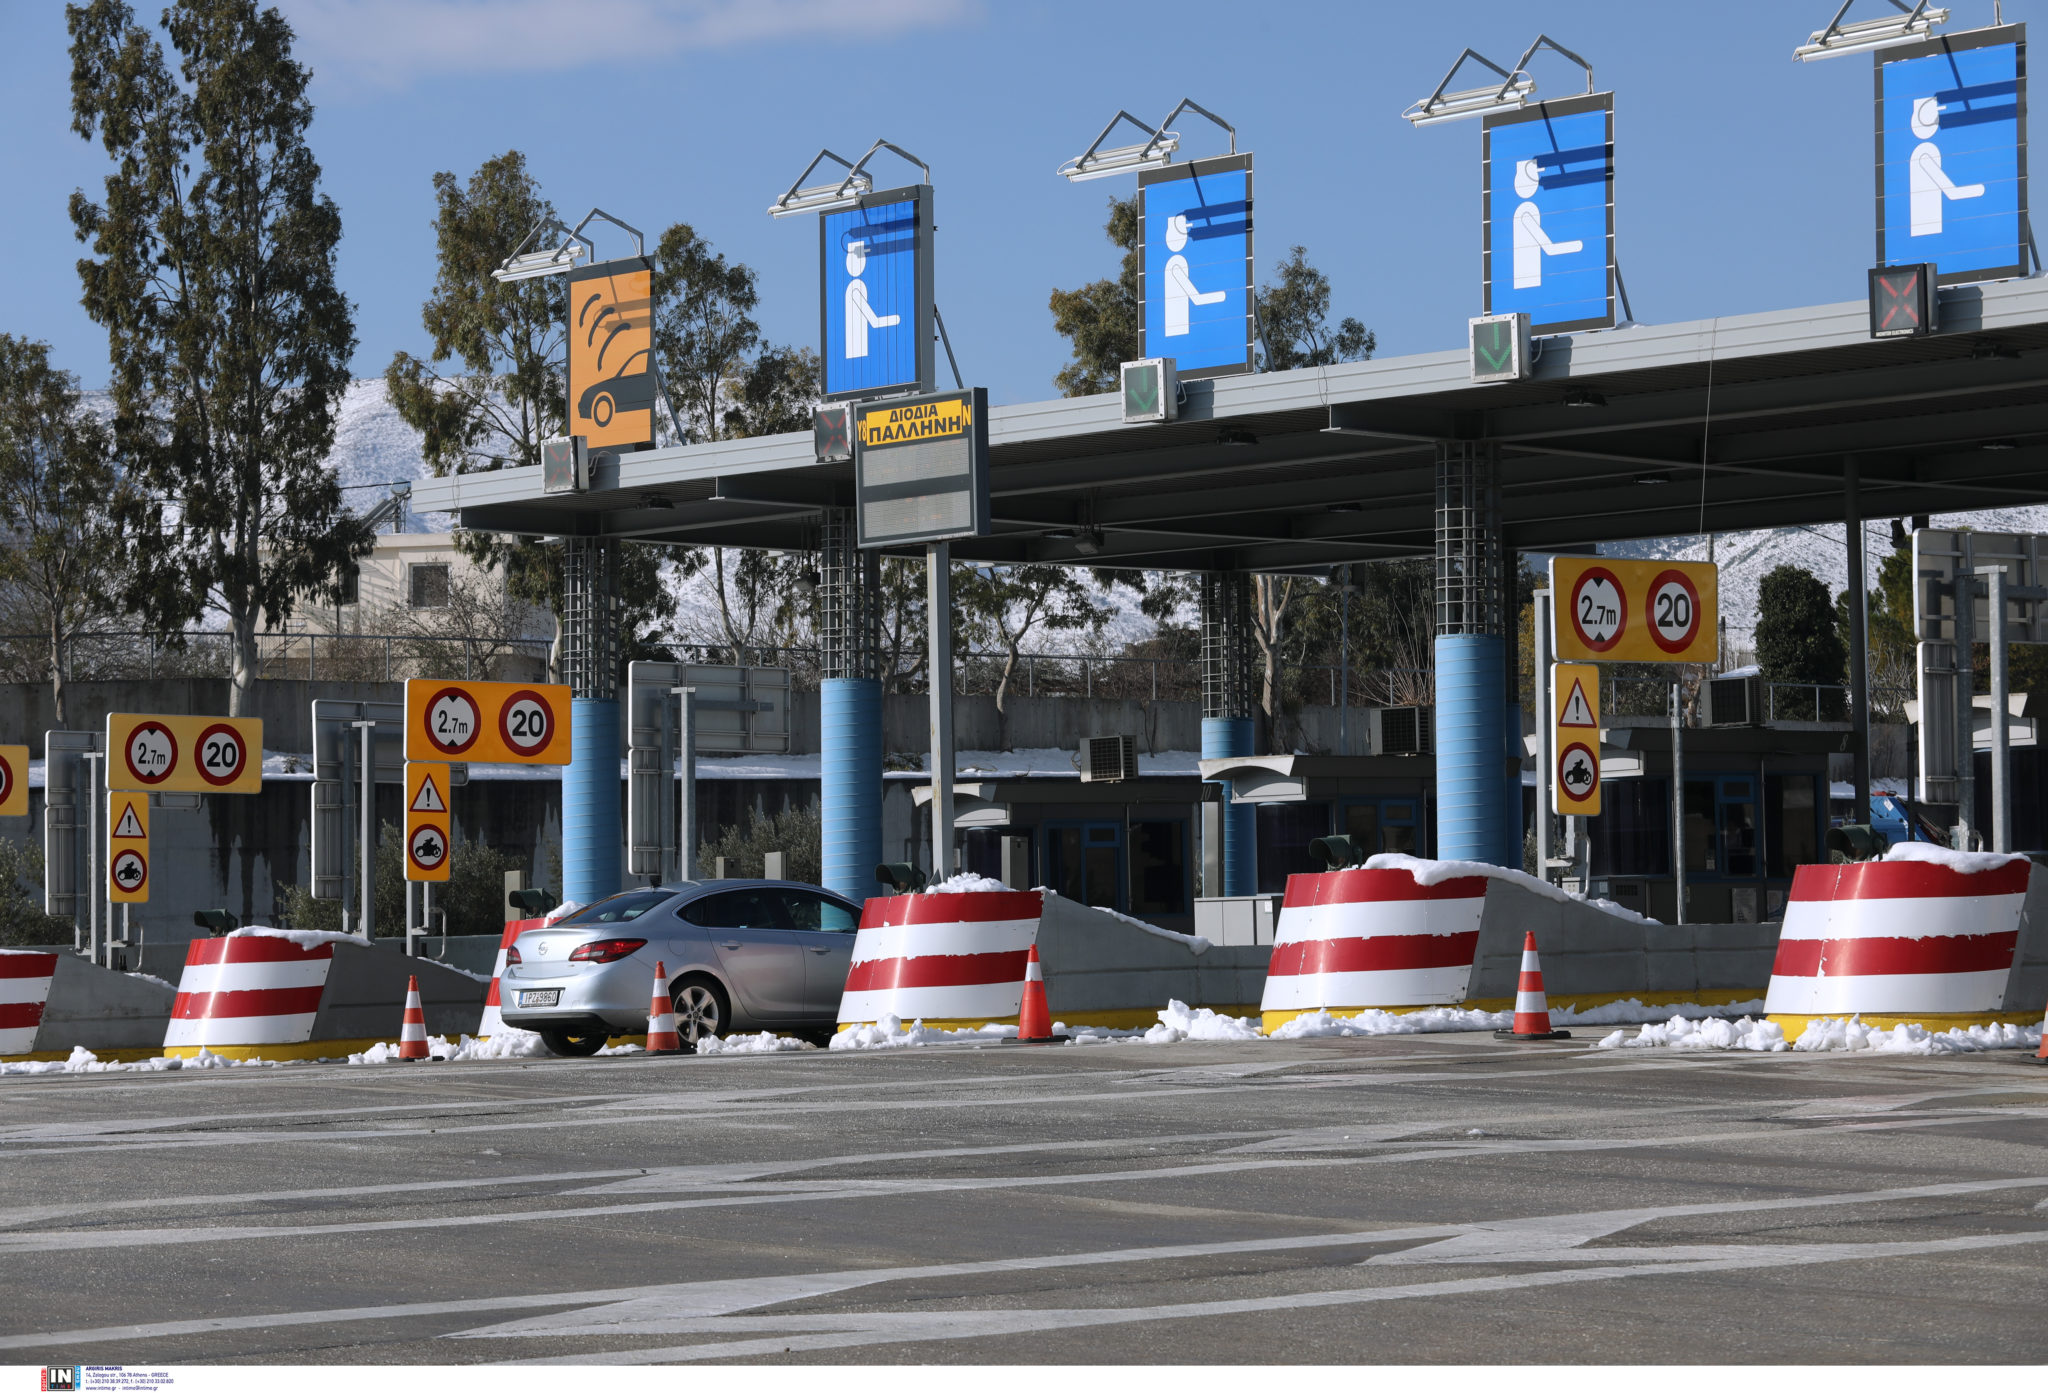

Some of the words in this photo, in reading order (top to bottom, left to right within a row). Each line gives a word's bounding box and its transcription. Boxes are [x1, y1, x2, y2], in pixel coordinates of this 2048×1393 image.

[889, 404, 938, 423] ΔΙΟΔΙΑ
[869, 416, 961, 443] ΠΑΛΛΗΝΗ
[1581, 595, 1617, 625] 2.7m
[1657, 593, 1690, 628] 20
[438, 710, 468, 734] 2.7m
[512, 709, 544, 738] 20
[138, 742, 166, 765] 2.7m
[206, 742, 237, 768] 20
